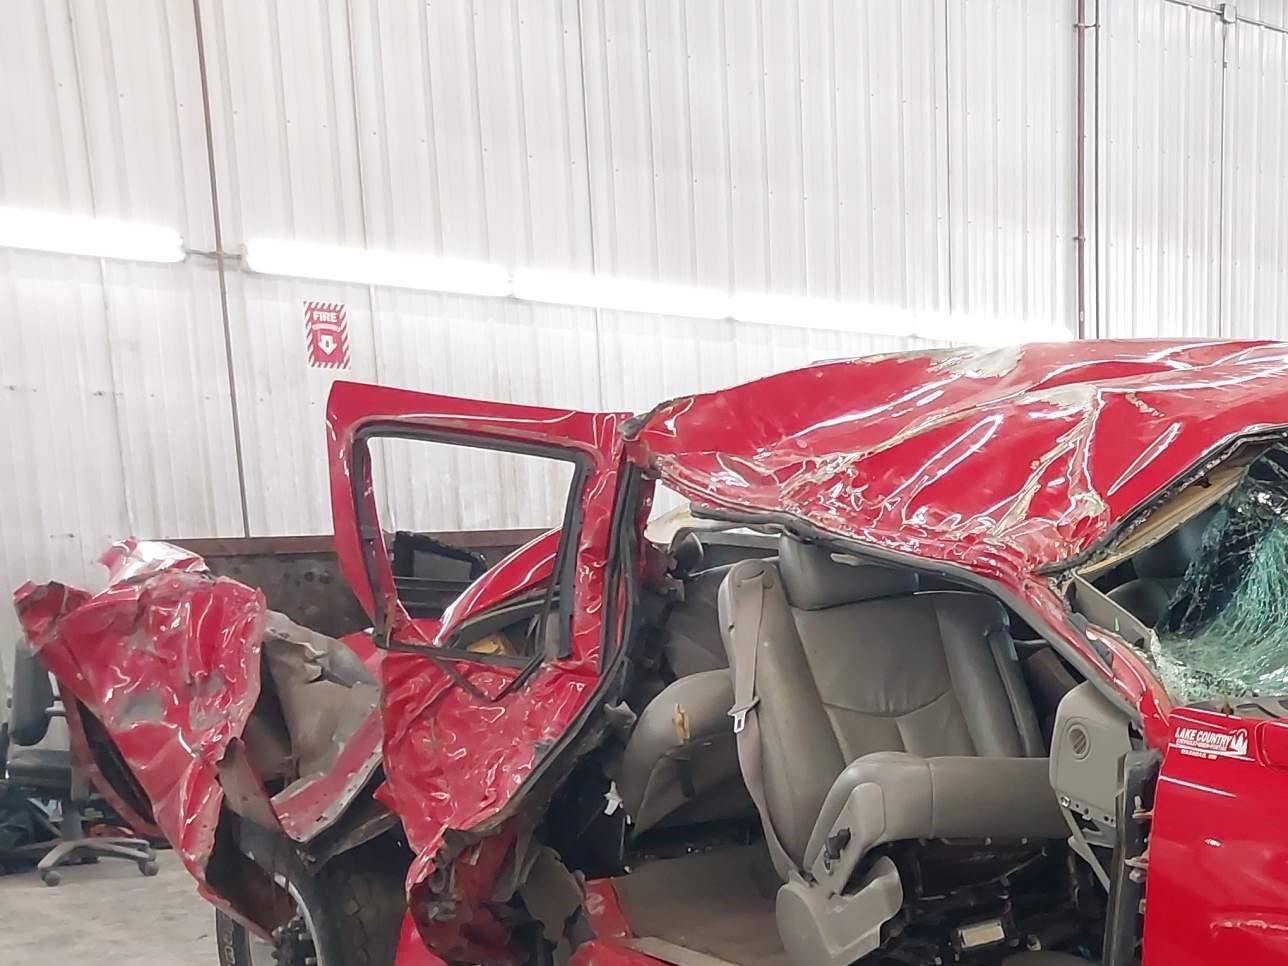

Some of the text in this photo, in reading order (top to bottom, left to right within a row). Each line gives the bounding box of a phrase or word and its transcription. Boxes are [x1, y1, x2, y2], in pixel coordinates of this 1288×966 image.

[313, 311, 338, 322] FIRE
[1174, 727, 1198, 741] LAKE
[1197, 731, 1233, 747] COUNTRY
